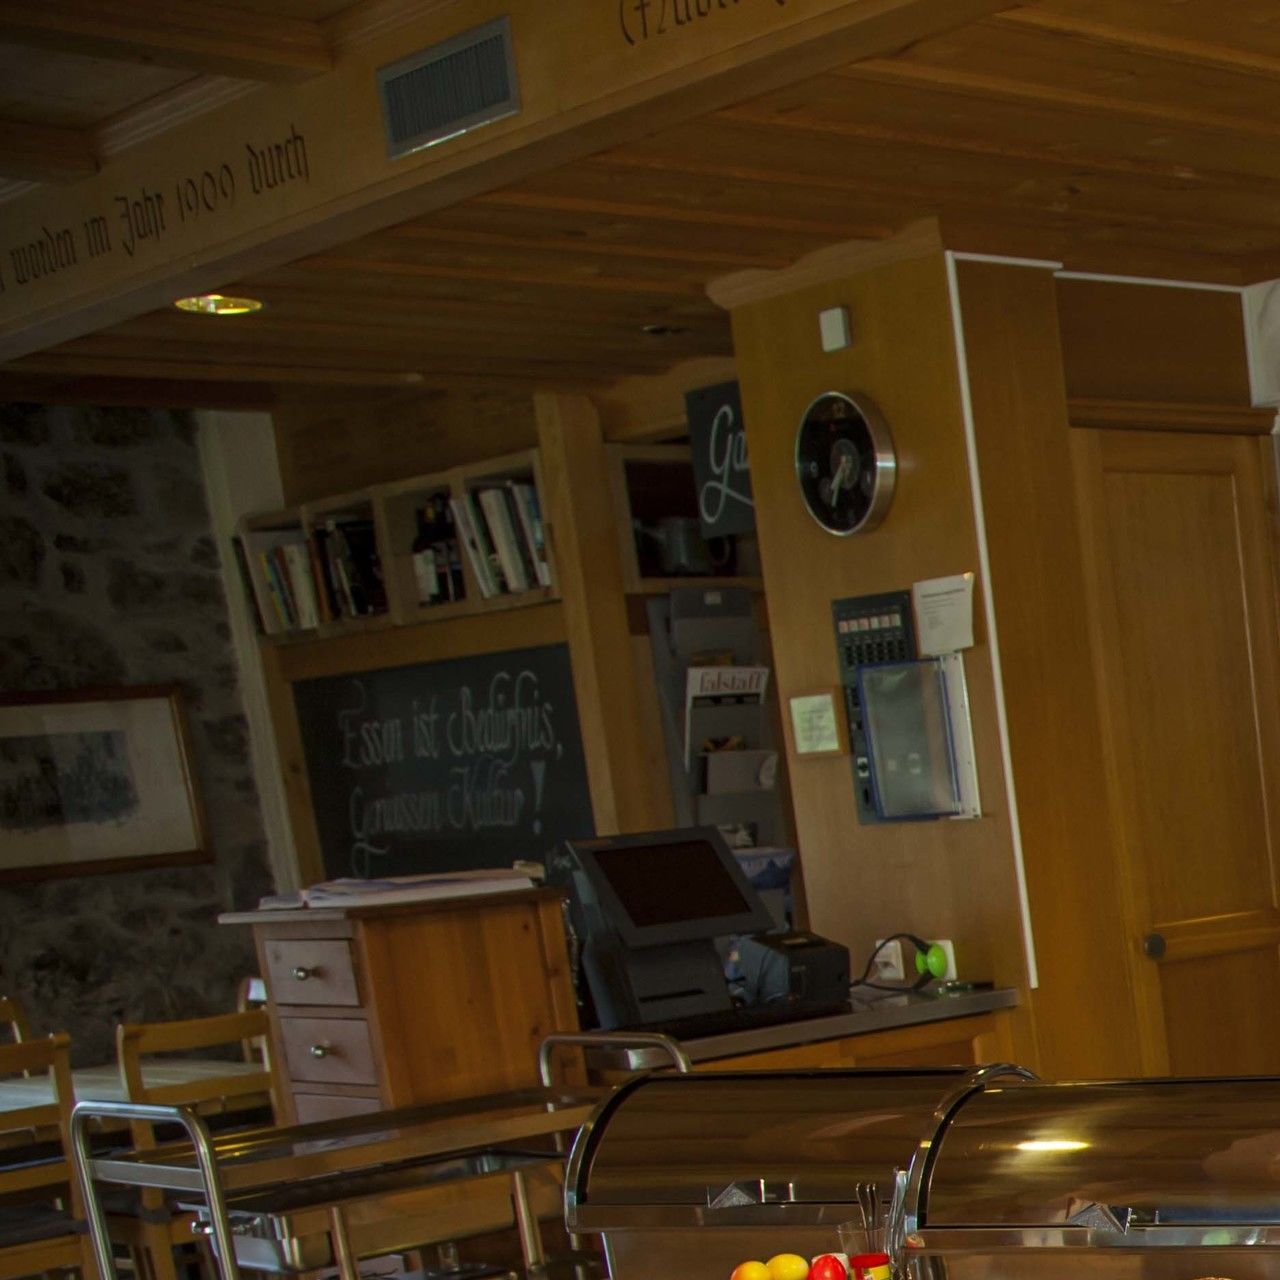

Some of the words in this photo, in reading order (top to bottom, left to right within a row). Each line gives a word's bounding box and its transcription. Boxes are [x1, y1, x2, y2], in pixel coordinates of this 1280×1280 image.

[9, 226, 78, 284] worden
[83, 215, 113, 257] im
[245, 123, 310, 194] durch
[339, 679, 404, 768] Essen
[412, 698, 440, 758] ist
[700, 671, 763, 693] falstaff
